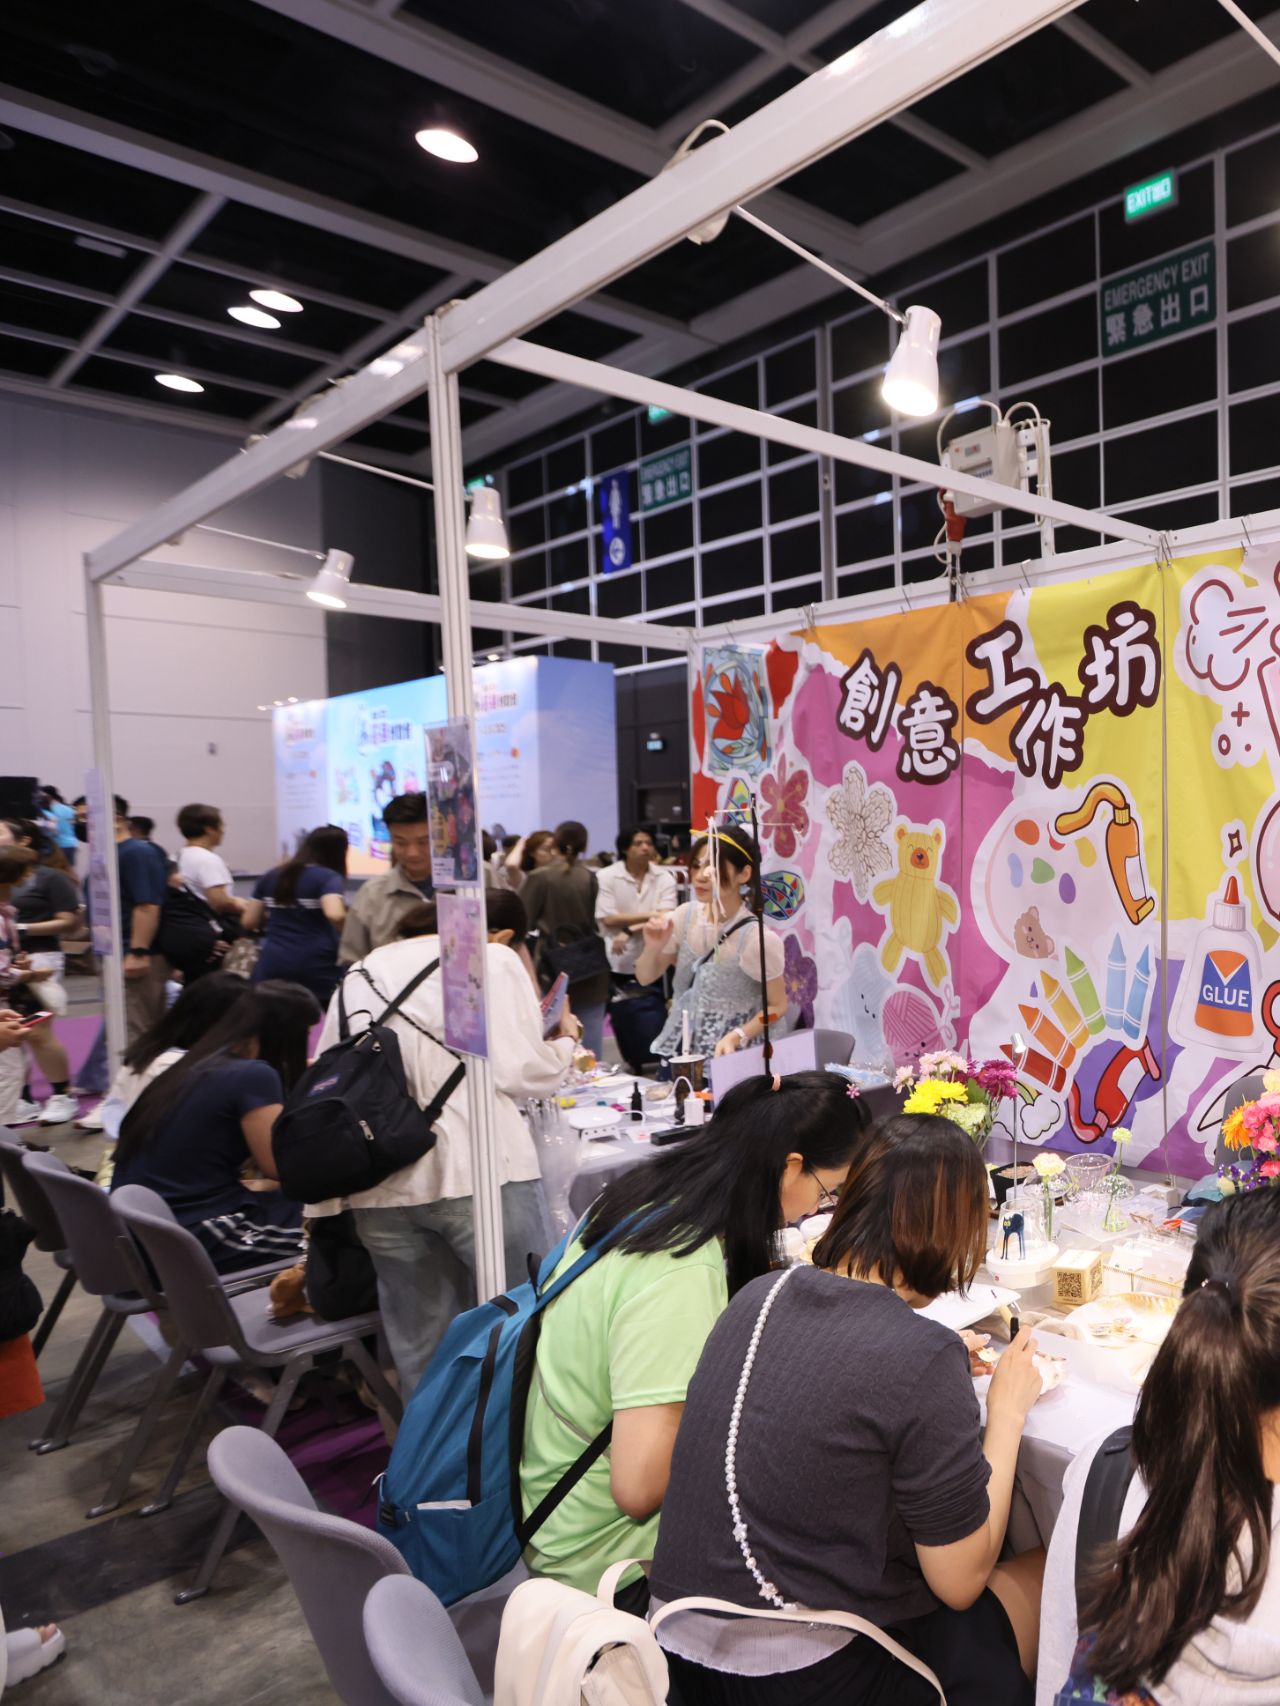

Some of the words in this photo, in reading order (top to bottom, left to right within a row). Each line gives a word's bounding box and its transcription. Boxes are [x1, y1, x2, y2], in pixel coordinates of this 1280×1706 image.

[1104, 263, 1180, 311] EMERGENCY
[1181, 252, 1210, 283] EXIT
[1105, 284, 1209, 347] 緊急出口
[1202, 984, 1250, 1008] GLUE
